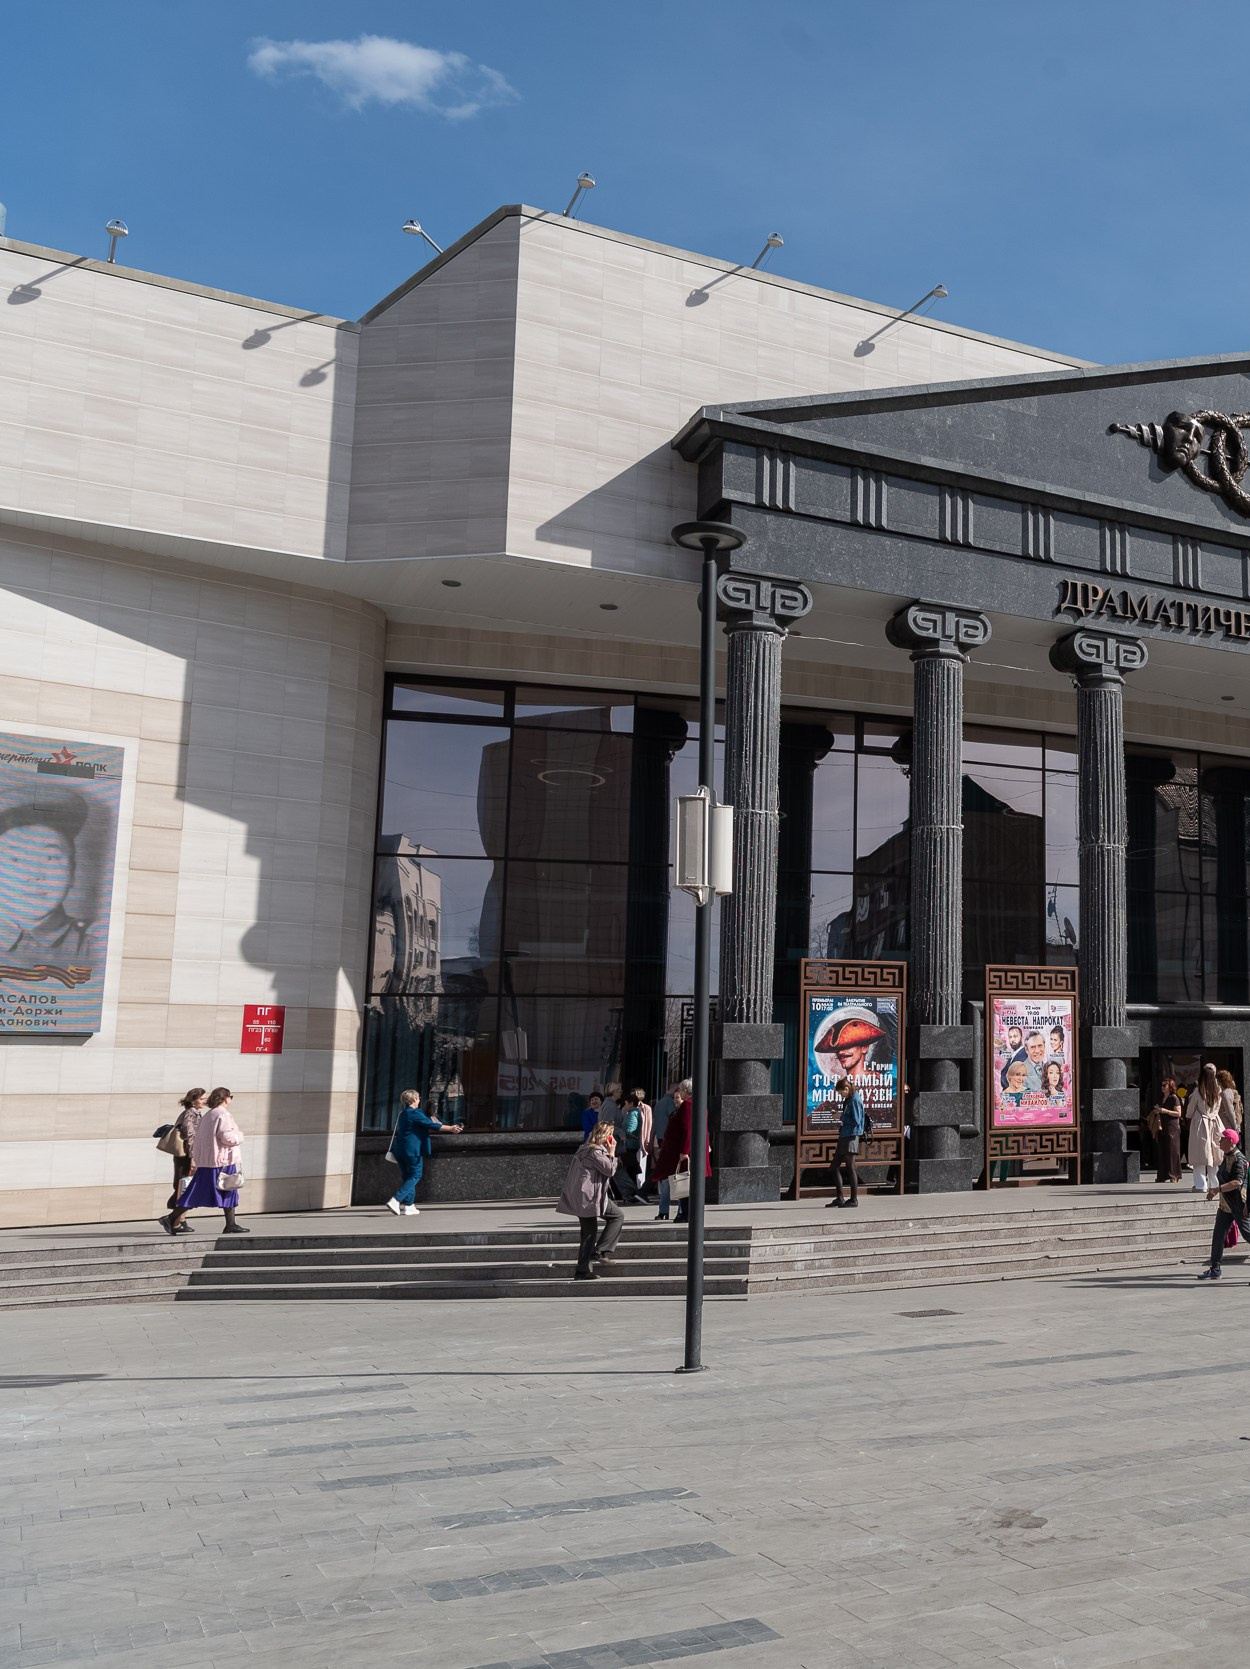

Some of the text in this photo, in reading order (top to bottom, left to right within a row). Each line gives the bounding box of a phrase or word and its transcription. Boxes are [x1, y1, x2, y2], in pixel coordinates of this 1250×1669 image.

[257, 1007, 272, 1016] ПГ
[812, 1002, 821, 1011] 10
[1002, 1016, 1064, 1026] НЕВЕСТА НАПРОКАТ
[812, 1073, 840, 1087] ТОТ
[812, 1088, 893, 1103] МЮНАУЗЕН
